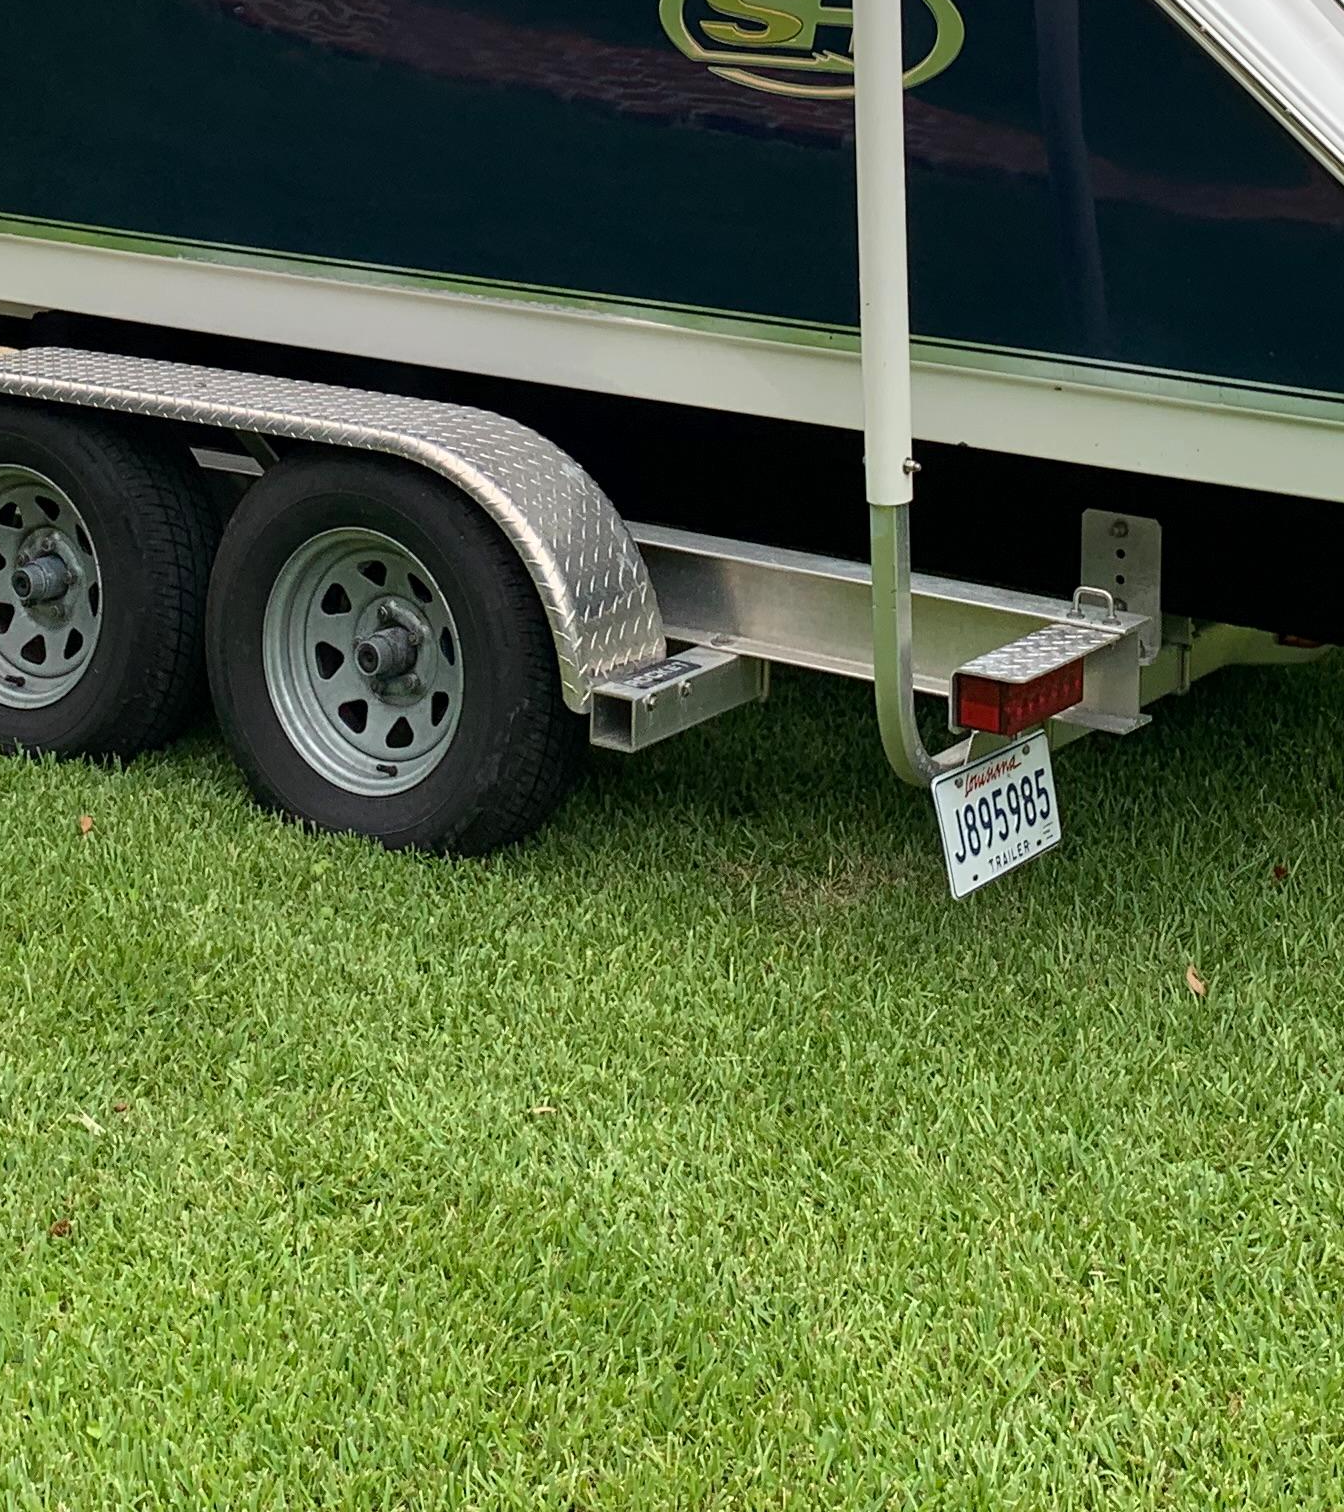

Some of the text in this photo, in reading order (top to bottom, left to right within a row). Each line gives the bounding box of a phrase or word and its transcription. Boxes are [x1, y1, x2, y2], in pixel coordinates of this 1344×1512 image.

[964, 755, 1022, 798] Louisiana
[955, 768, 1051, 864] J895985
[988, 839, 1031, 873] TRAILER
